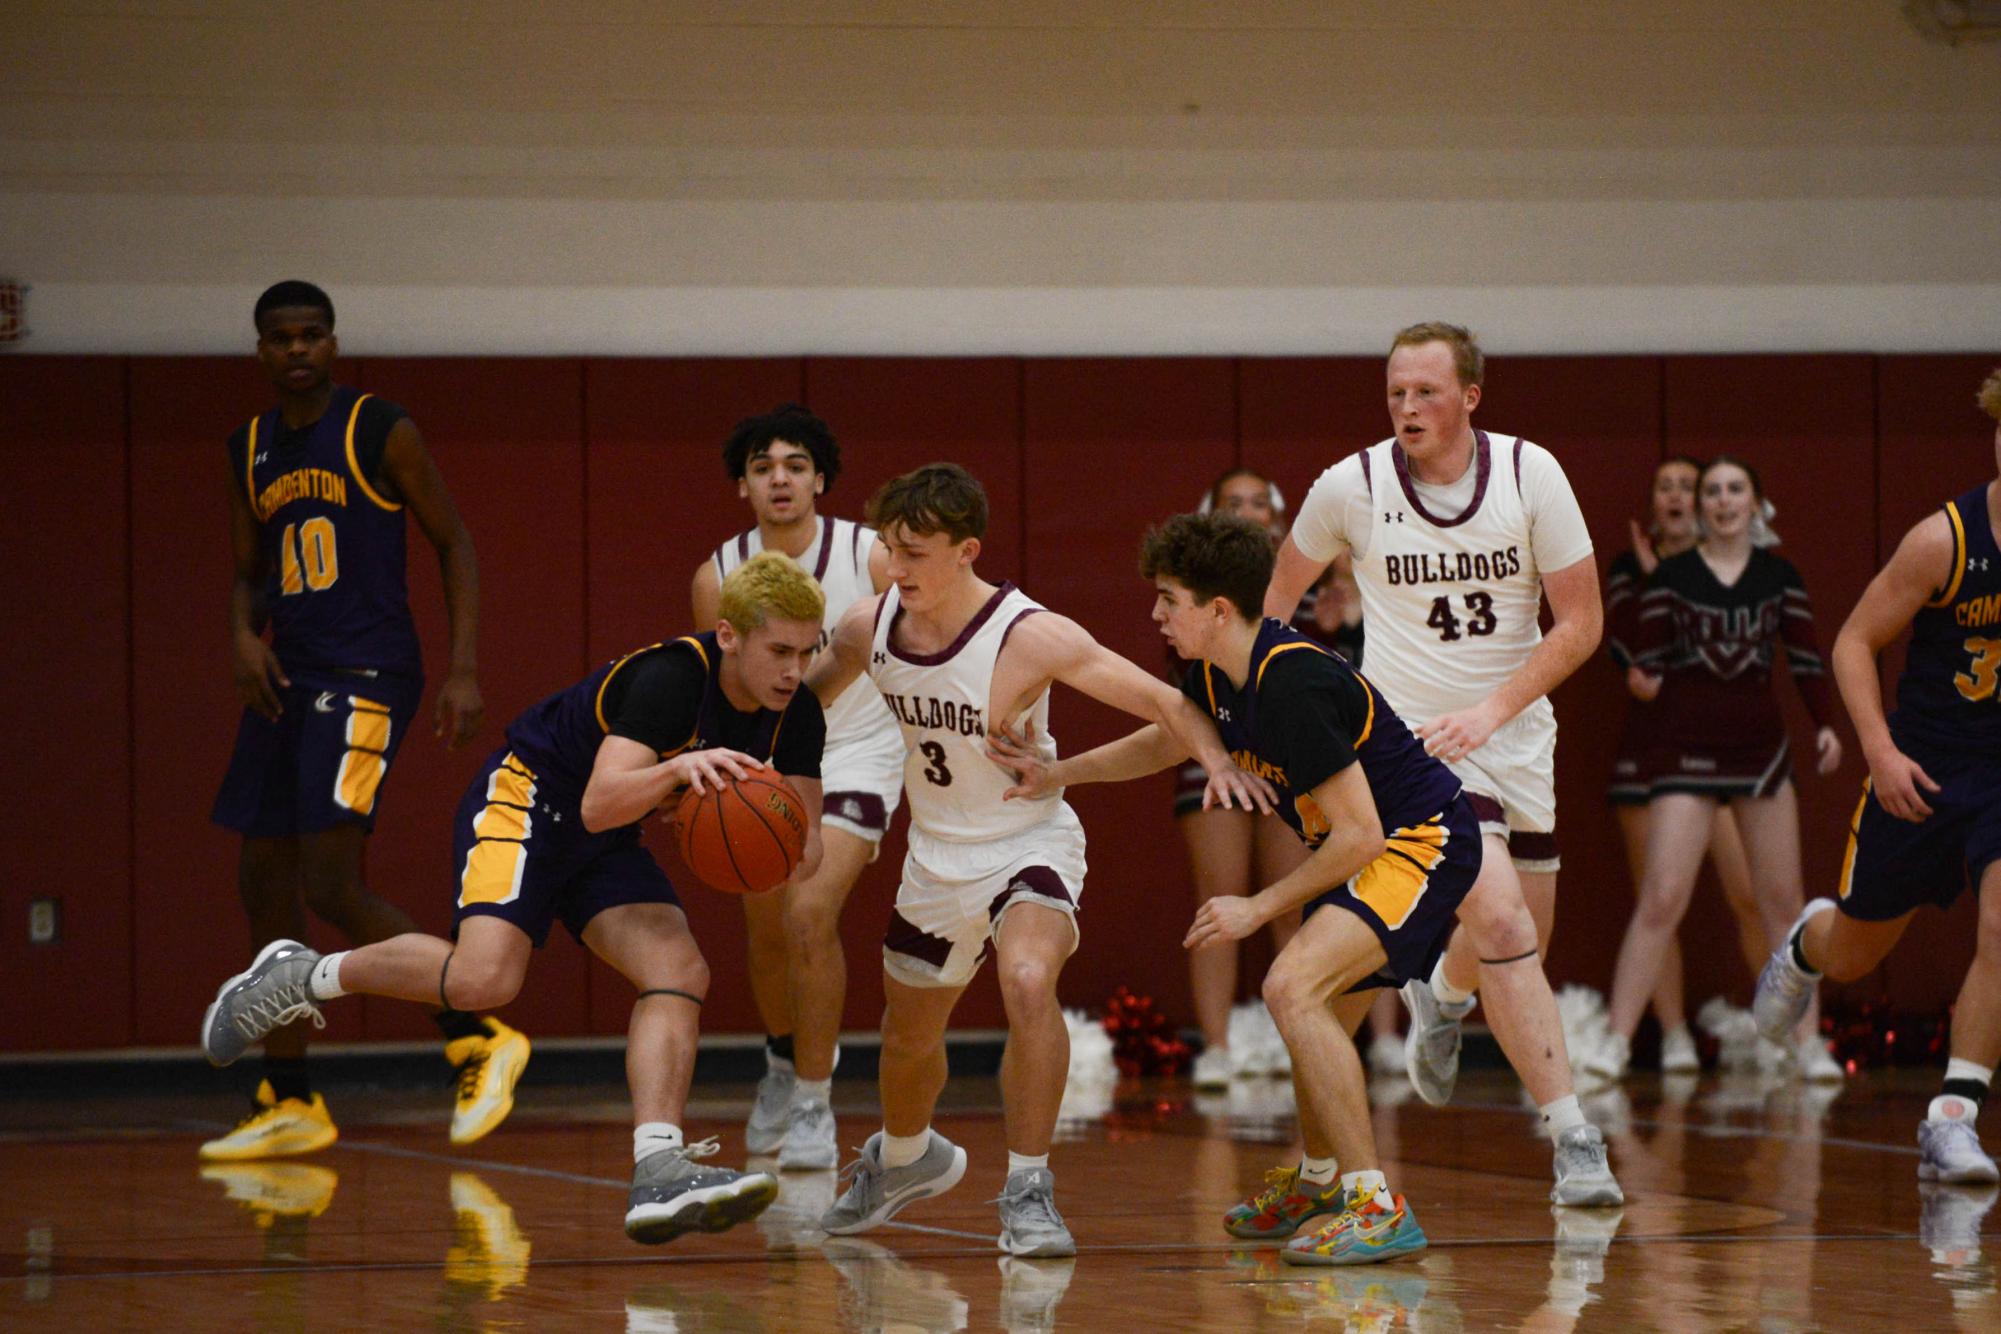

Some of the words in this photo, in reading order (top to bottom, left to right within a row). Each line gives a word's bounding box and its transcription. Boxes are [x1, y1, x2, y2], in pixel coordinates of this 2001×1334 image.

[281, 516, 339, 596] 10
[1385, 545, 1520, 586] BULLDOGS
[1426, 591, 1498, 642] 43
[1953, 634, 2001, 702] 3
[919, 740, 953, 787] 3
